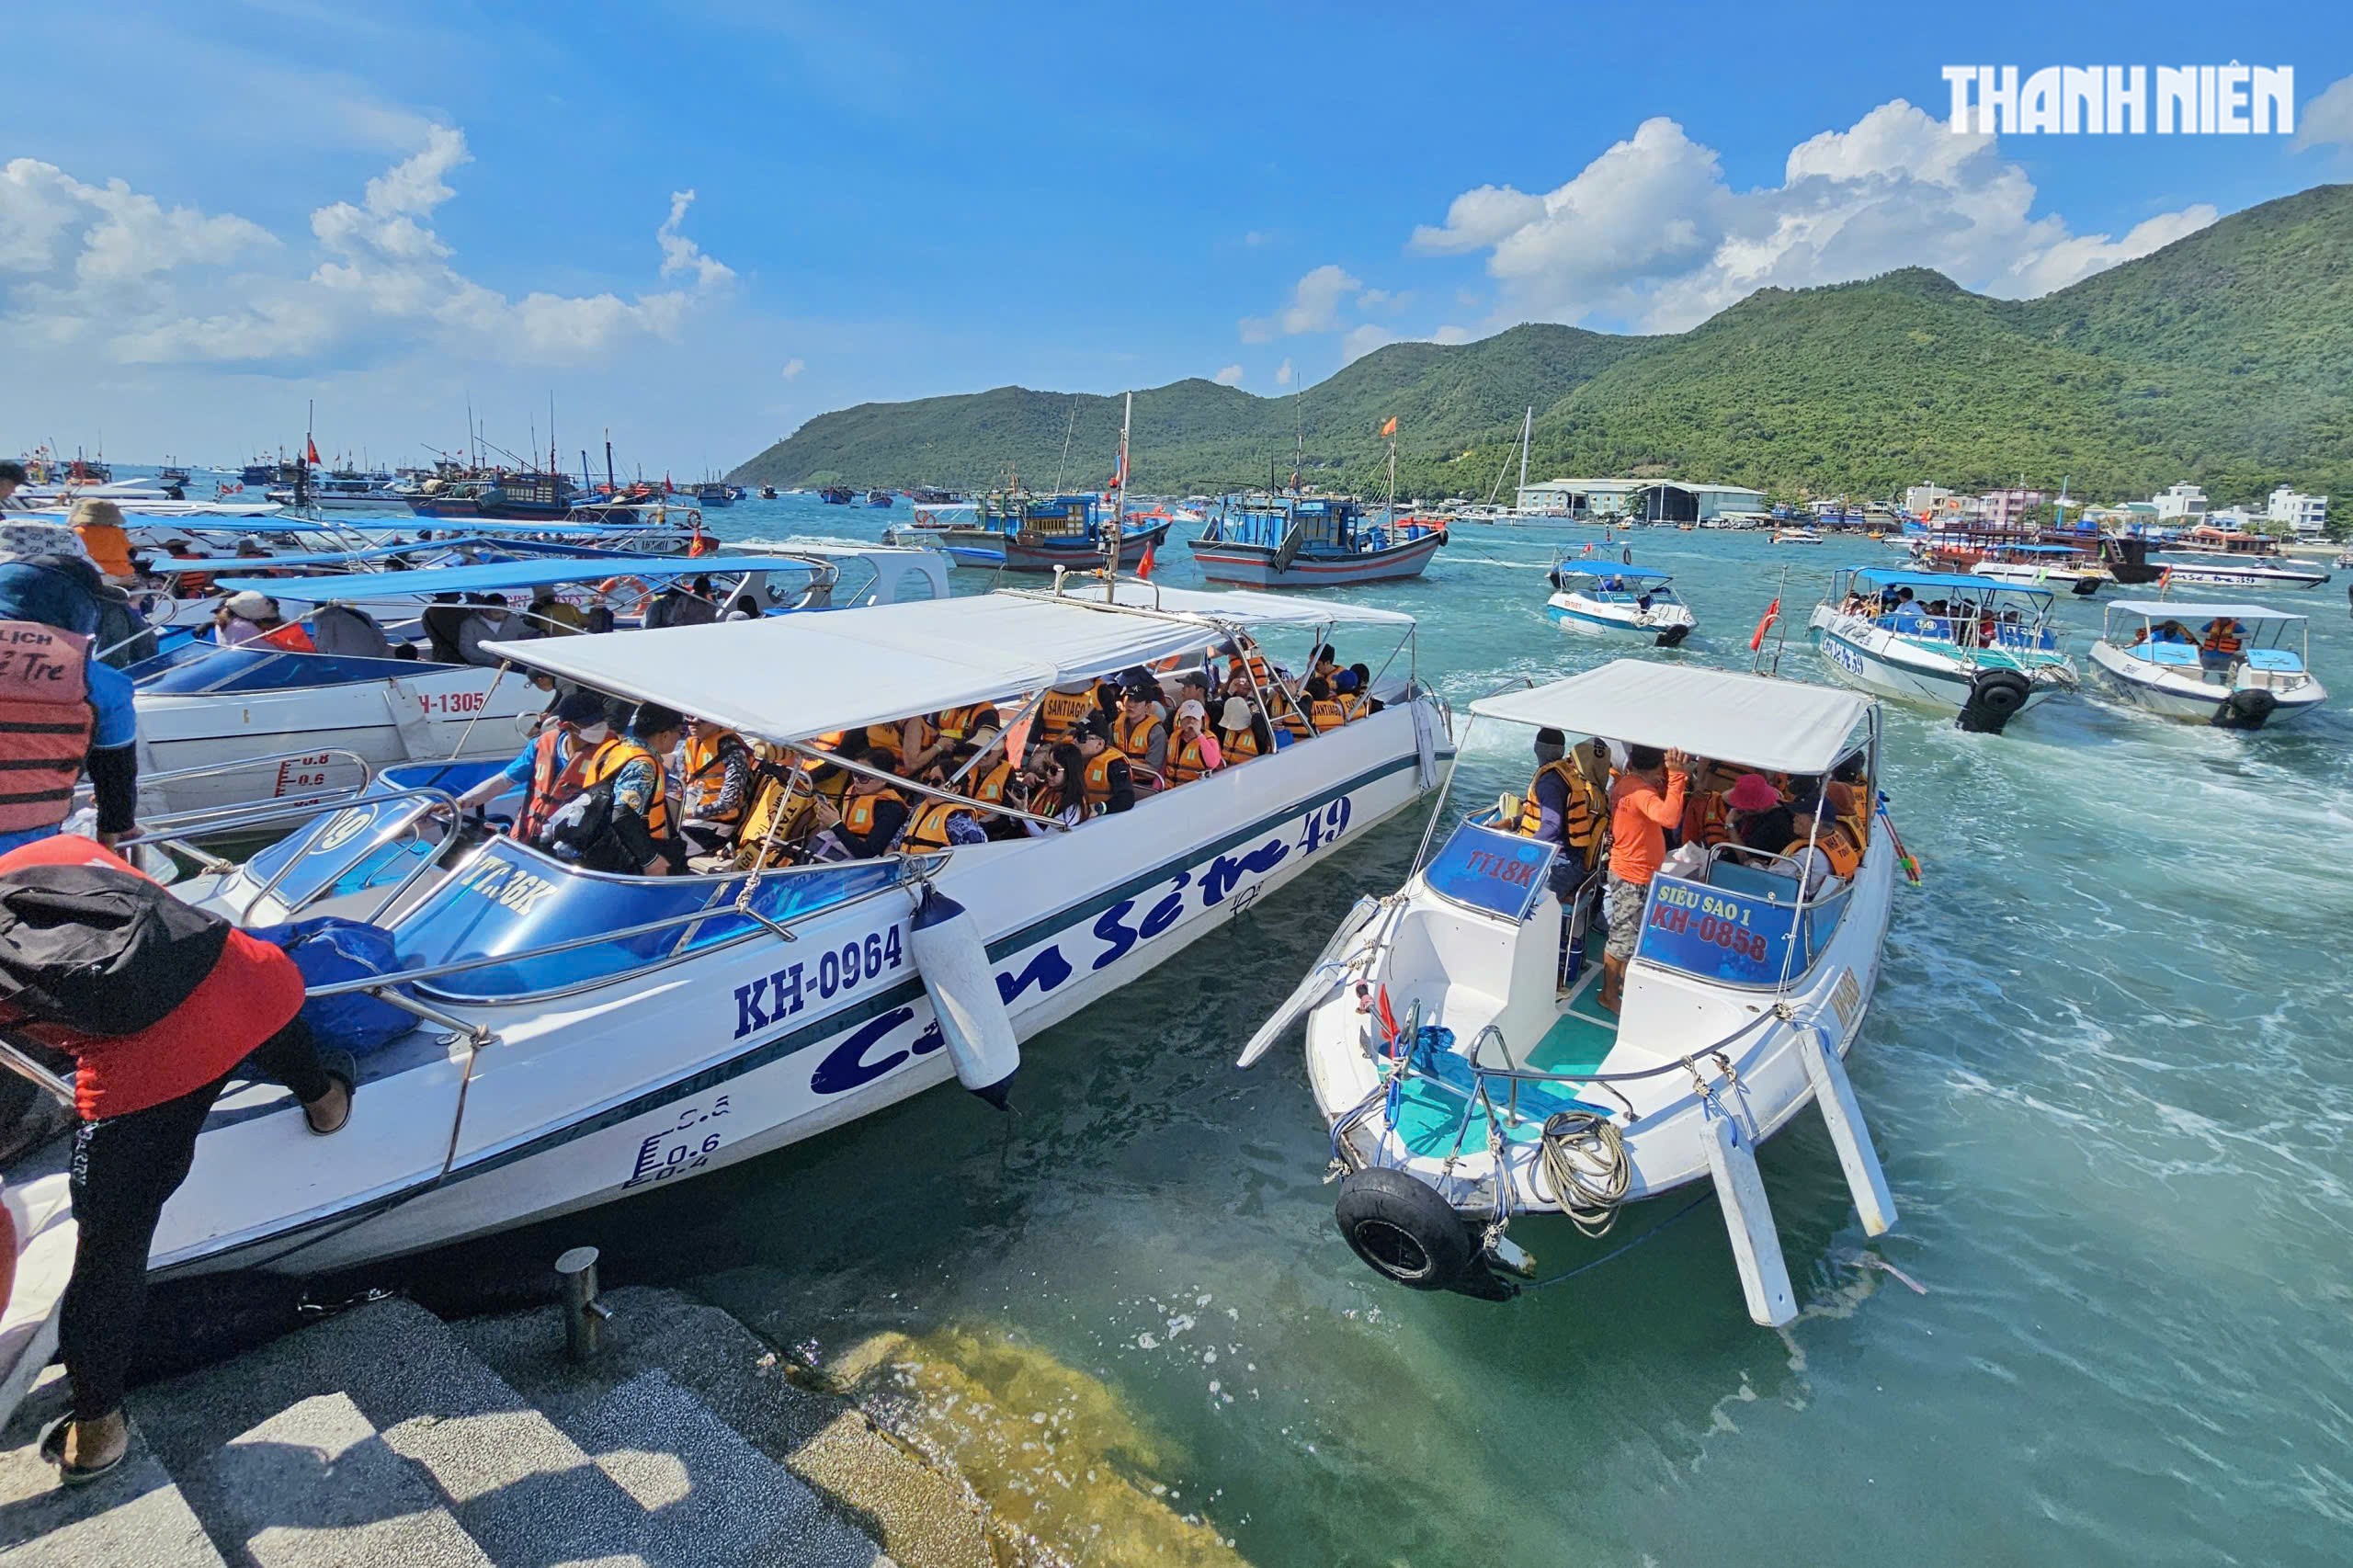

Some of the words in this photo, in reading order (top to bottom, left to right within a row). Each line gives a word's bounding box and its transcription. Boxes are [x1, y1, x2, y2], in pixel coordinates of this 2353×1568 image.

[22, 653, 64, 682] Tre
[419, 692, 483, 713] H-1305
[1296, 796, 1352, 859] 49
[1466, 850, 1539, 889] TT18K
[1657, 884, 1700, 909] SIÊU
[1701, 896, 1738, 920] SAO
[1650, 903, 1768, 963] KH-0858
[733, 923, 903, 1040] KH-0964
[667, 1132, 721, 1165] 0.6
